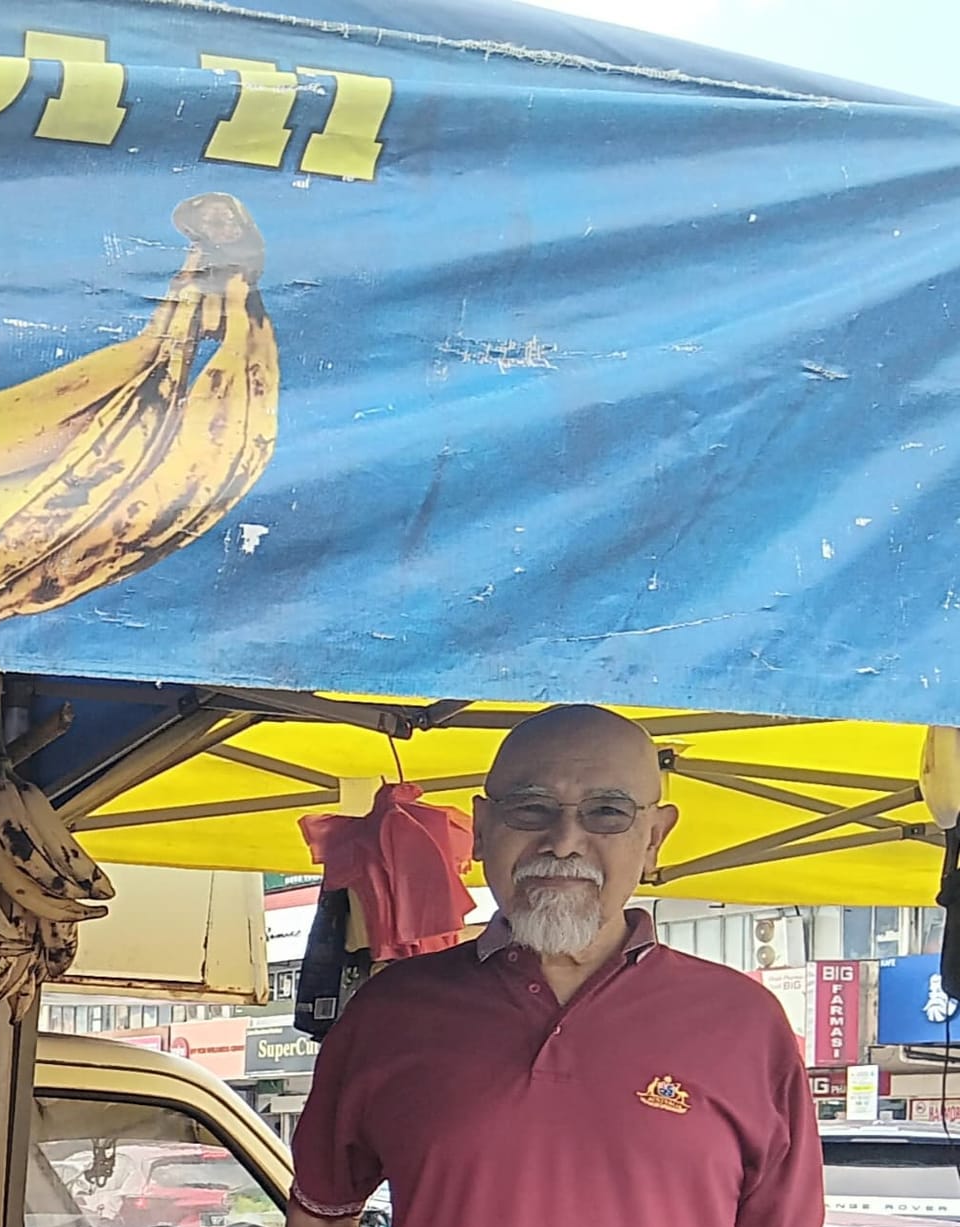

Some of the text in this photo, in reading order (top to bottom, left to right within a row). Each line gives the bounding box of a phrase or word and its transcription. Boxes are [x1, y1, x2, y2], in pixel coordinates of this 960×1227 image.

[822, 966, 854, 981] BIG
[830, 984, 844, 1059] FARMASI
[885, 1203, 947, 1211] ROVER
